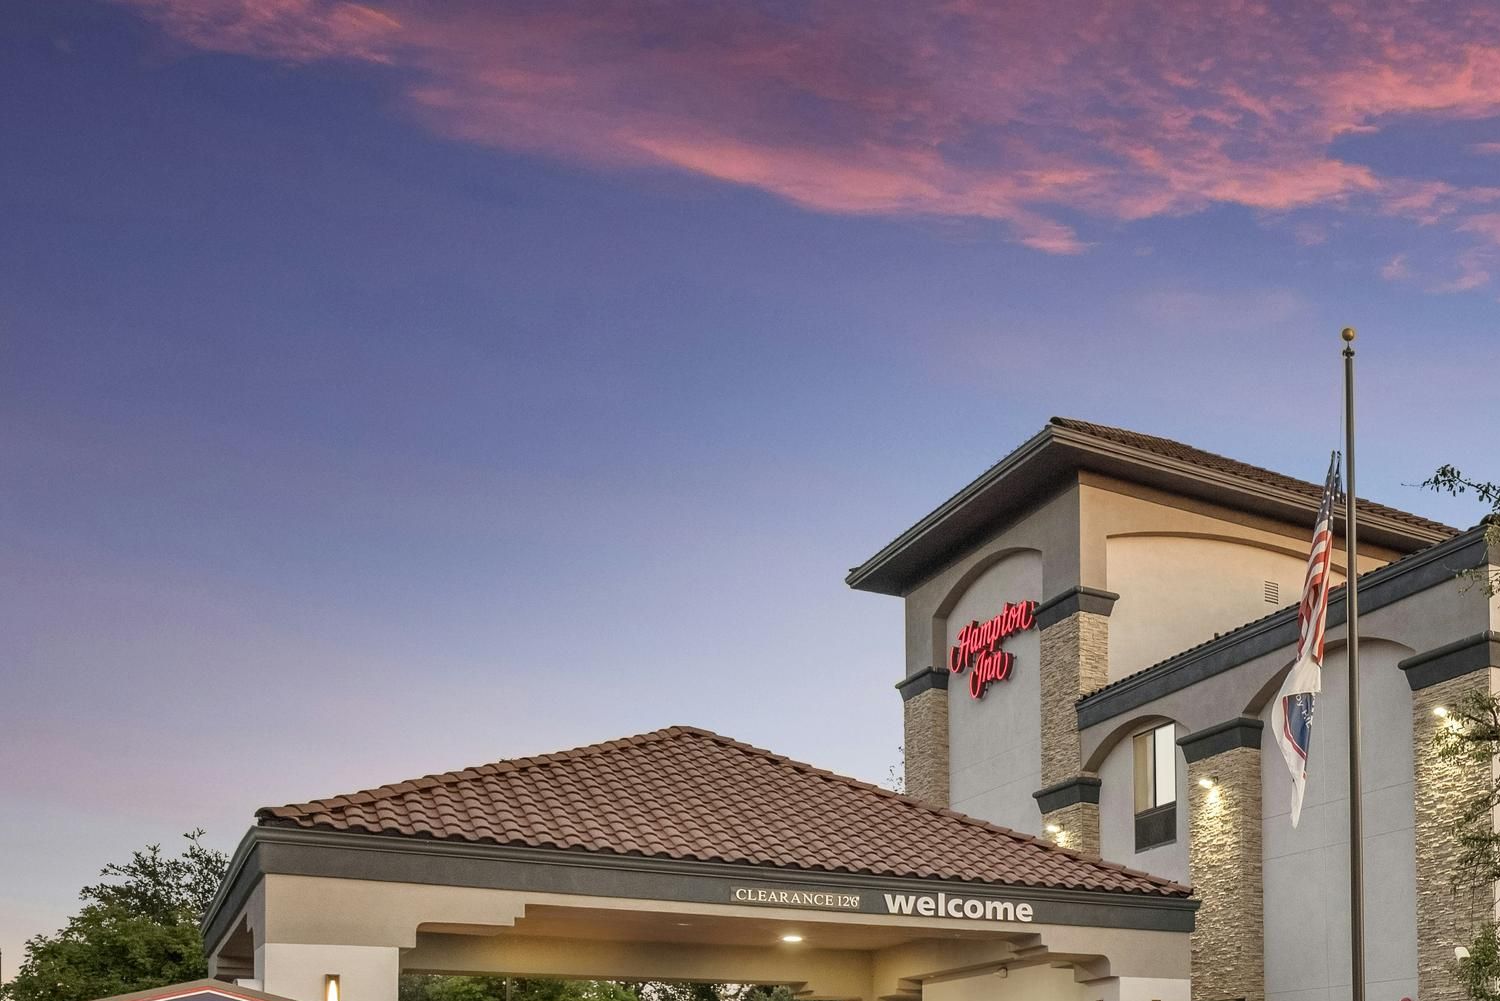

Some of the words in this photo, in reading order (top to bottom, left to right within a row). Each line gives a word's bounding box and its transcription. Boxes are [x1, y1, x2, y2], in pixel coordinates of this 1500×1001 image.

[949, 600, 1039, 673] Hampton
[969, 649, 1013, 698] Inn
[735, 888, 834, 906] CLEARANCE
[884, 892, 1033, 922] welcome
